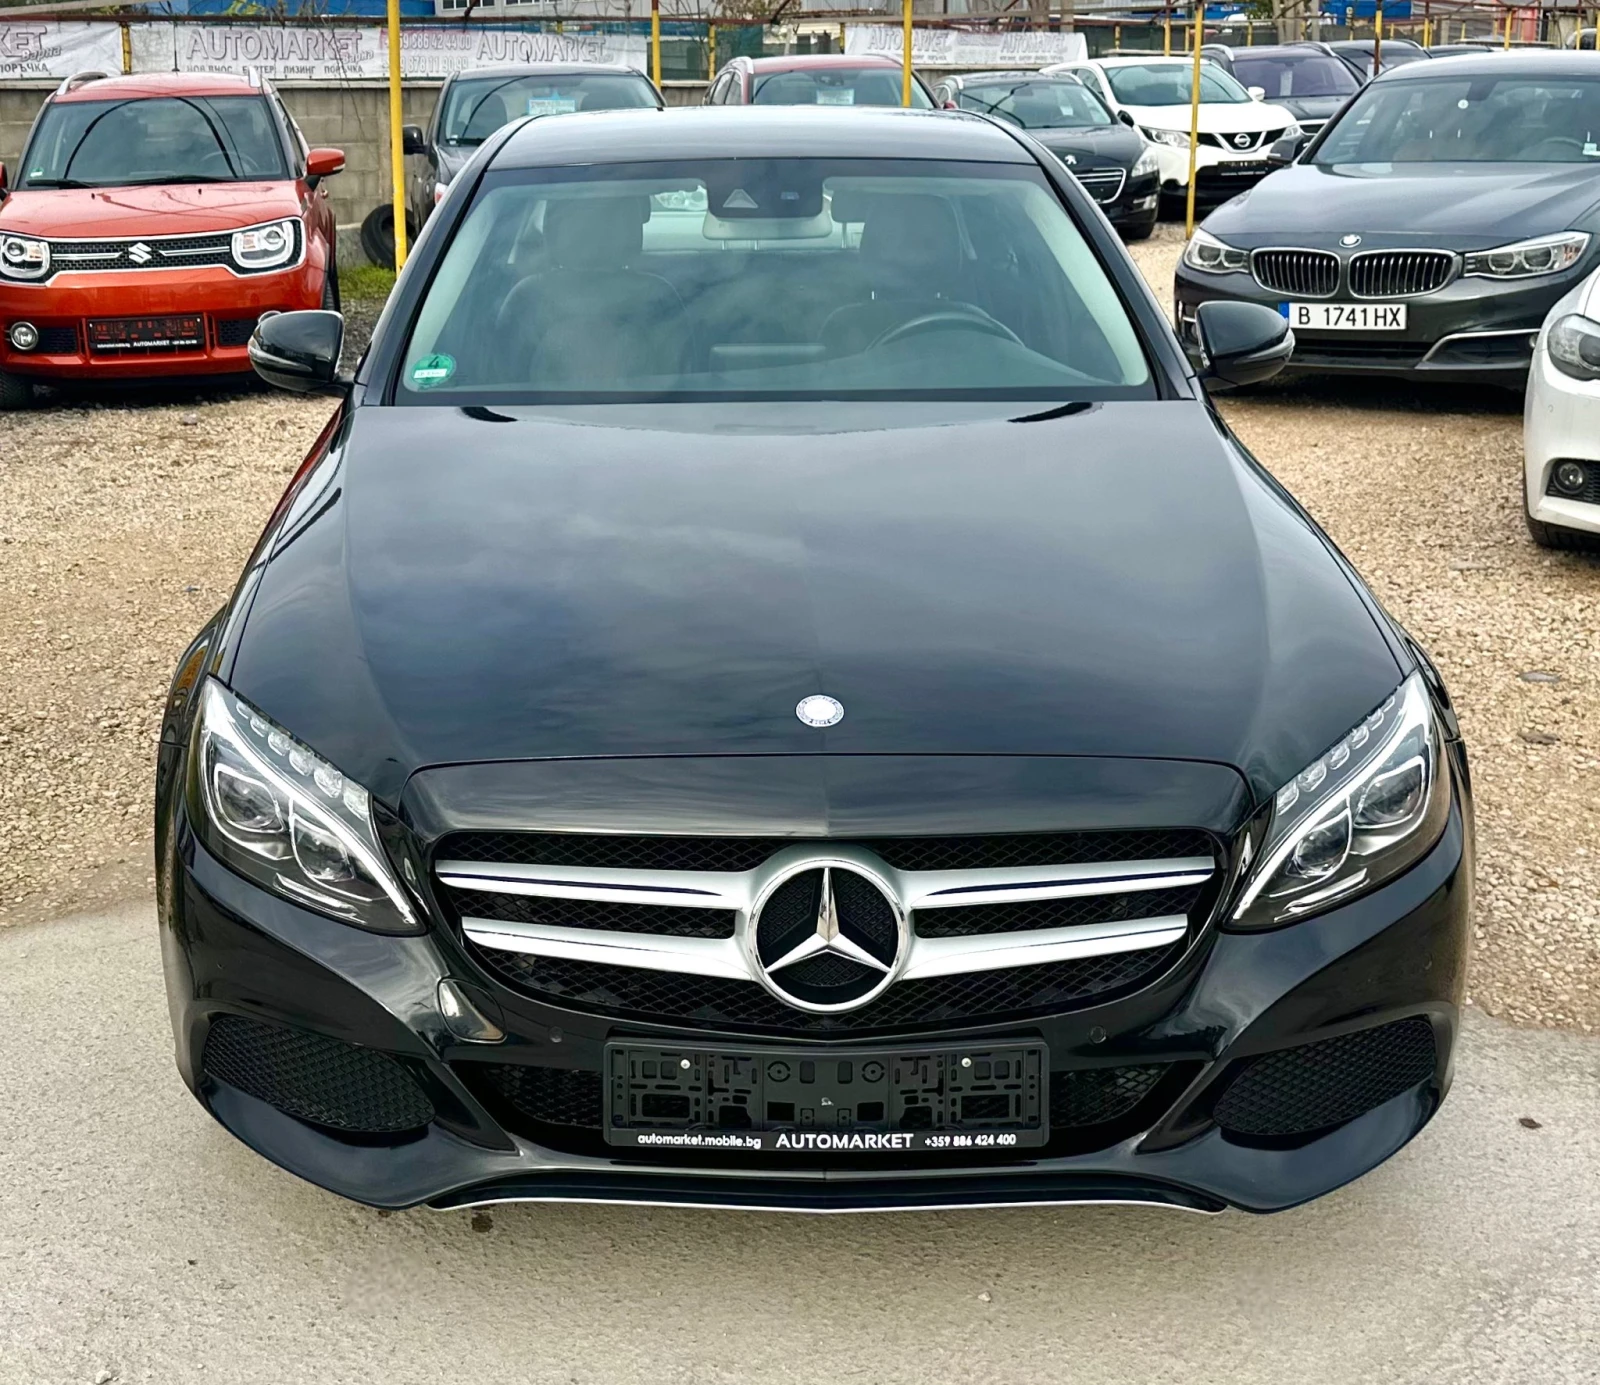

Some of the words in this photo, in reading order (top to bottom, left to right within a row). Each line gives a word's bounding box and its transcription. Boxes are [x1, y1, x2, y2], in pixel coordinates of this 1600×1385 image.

[186, 29, 362, 60] AUTOMARKET
[431, 34, 443, 49] 42
[445, 35, 457, 50] 44
[459, 35, 472, 50] 00
[476, 33, 606, 62] AUTOMARKET
[1298, 306, 1312, 326] B
[1323, 306, 1368, 327] 1741
[1374, 307, 1401, 327] HX
[133, 339, 170, 347] AUTOMARKET
[427, 355, 440, 369] 4
[637, 1132, 762, 1149] automarket.mobile.bg
[775, 1133, 914, 1149] AUTOMARKET
[924, 1136, 951, 1147] +359
[952, 1135, 973, 1147] 886
[974, 1134, 995, 1146] 424
[996, 1133, 1017, 1146] 400
